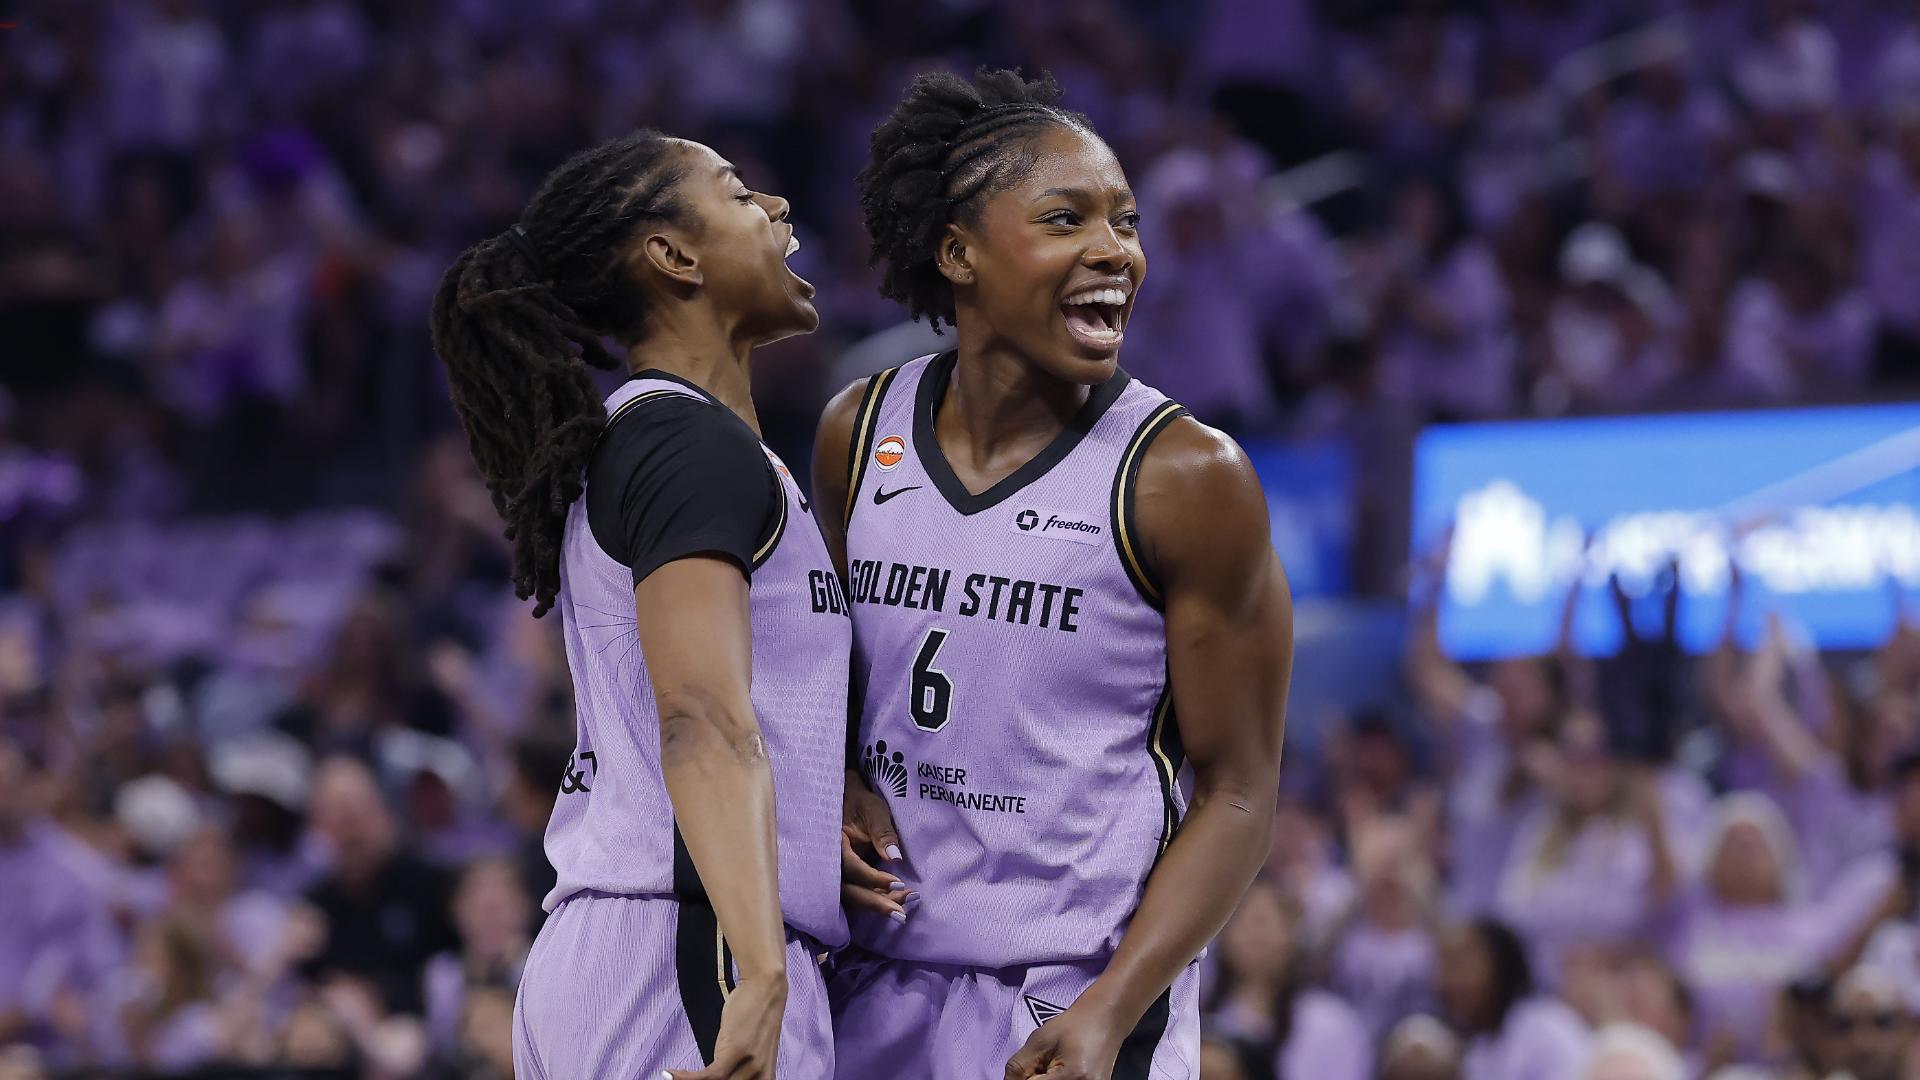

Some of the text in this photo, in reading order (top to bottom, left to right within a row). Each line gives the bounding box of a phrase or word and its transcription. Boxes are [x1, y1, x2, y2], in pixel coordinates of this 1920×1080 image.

[1042, 515, 1101, 534] freedom
[850, 559, 1083, 632] GOLDEN STATE
[908, 627, 955, 733] 6
[917, 761, 966, 785] KAISER
[919, 783, 1026, 813] PERMANENTE
